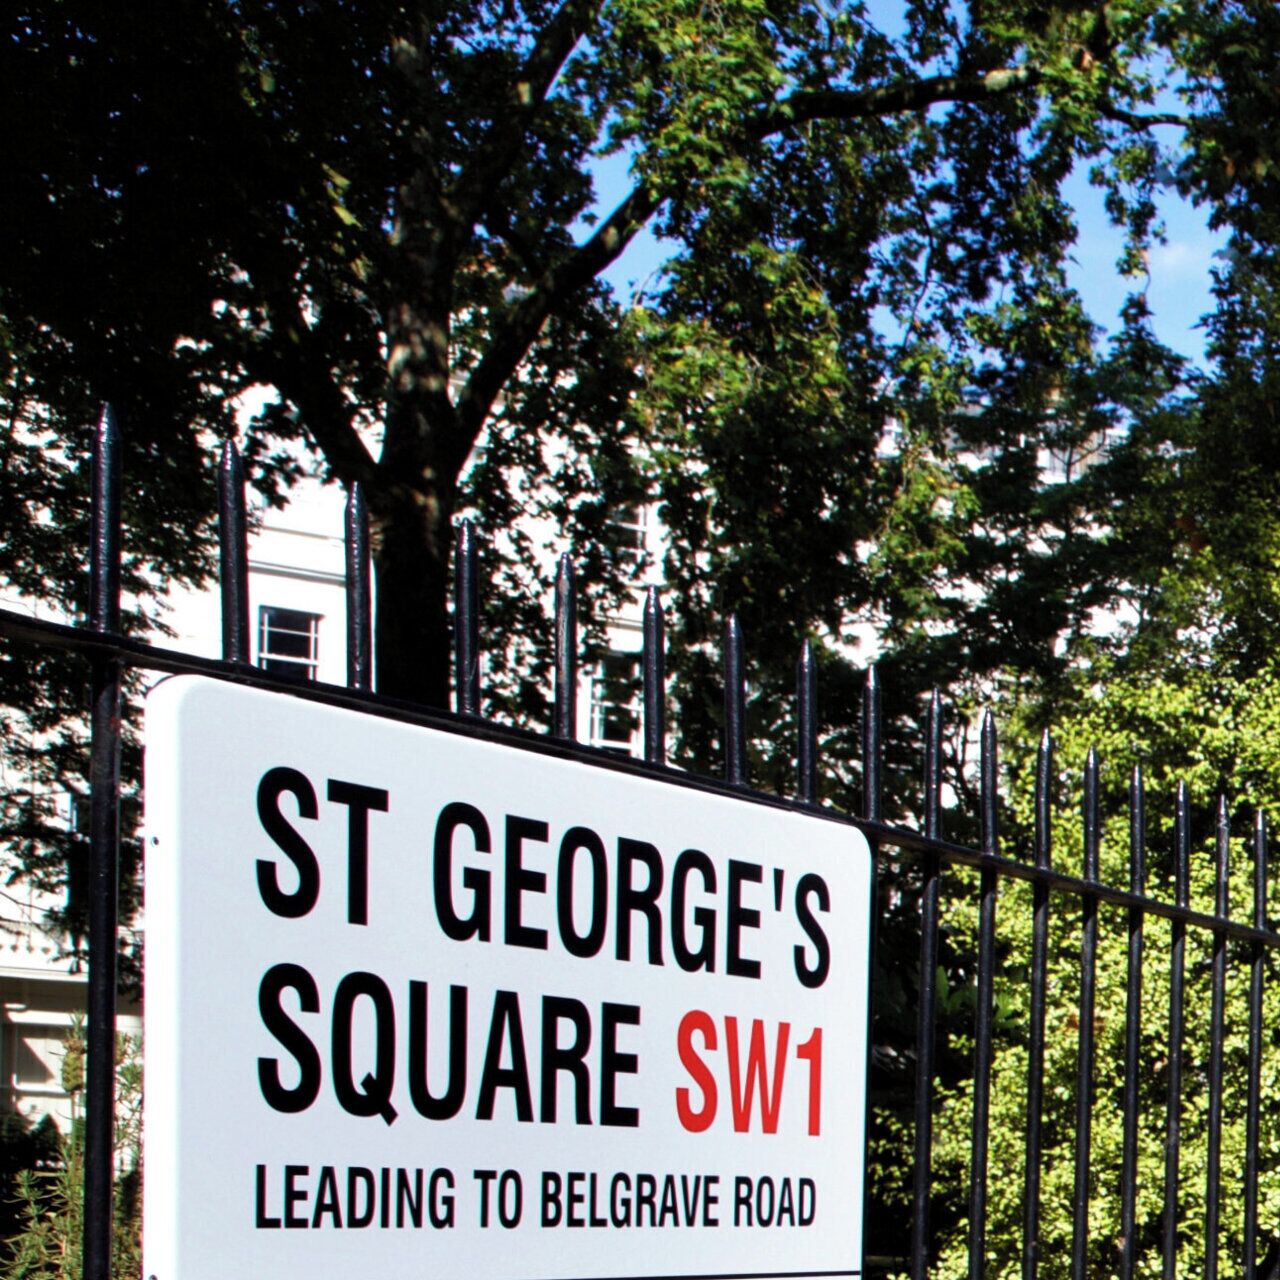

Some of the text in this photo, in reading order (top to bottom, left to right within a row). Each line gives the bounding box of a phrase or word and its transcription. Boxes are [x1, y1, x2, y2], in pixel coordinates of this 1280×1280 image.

[256, 767, 830, 988] ST GEORGE'S
[257, 962, 824, 1136] SQUARE SW1
[255, 1164, 816, 1229] LEADING TO BELGRAVE ROAD
